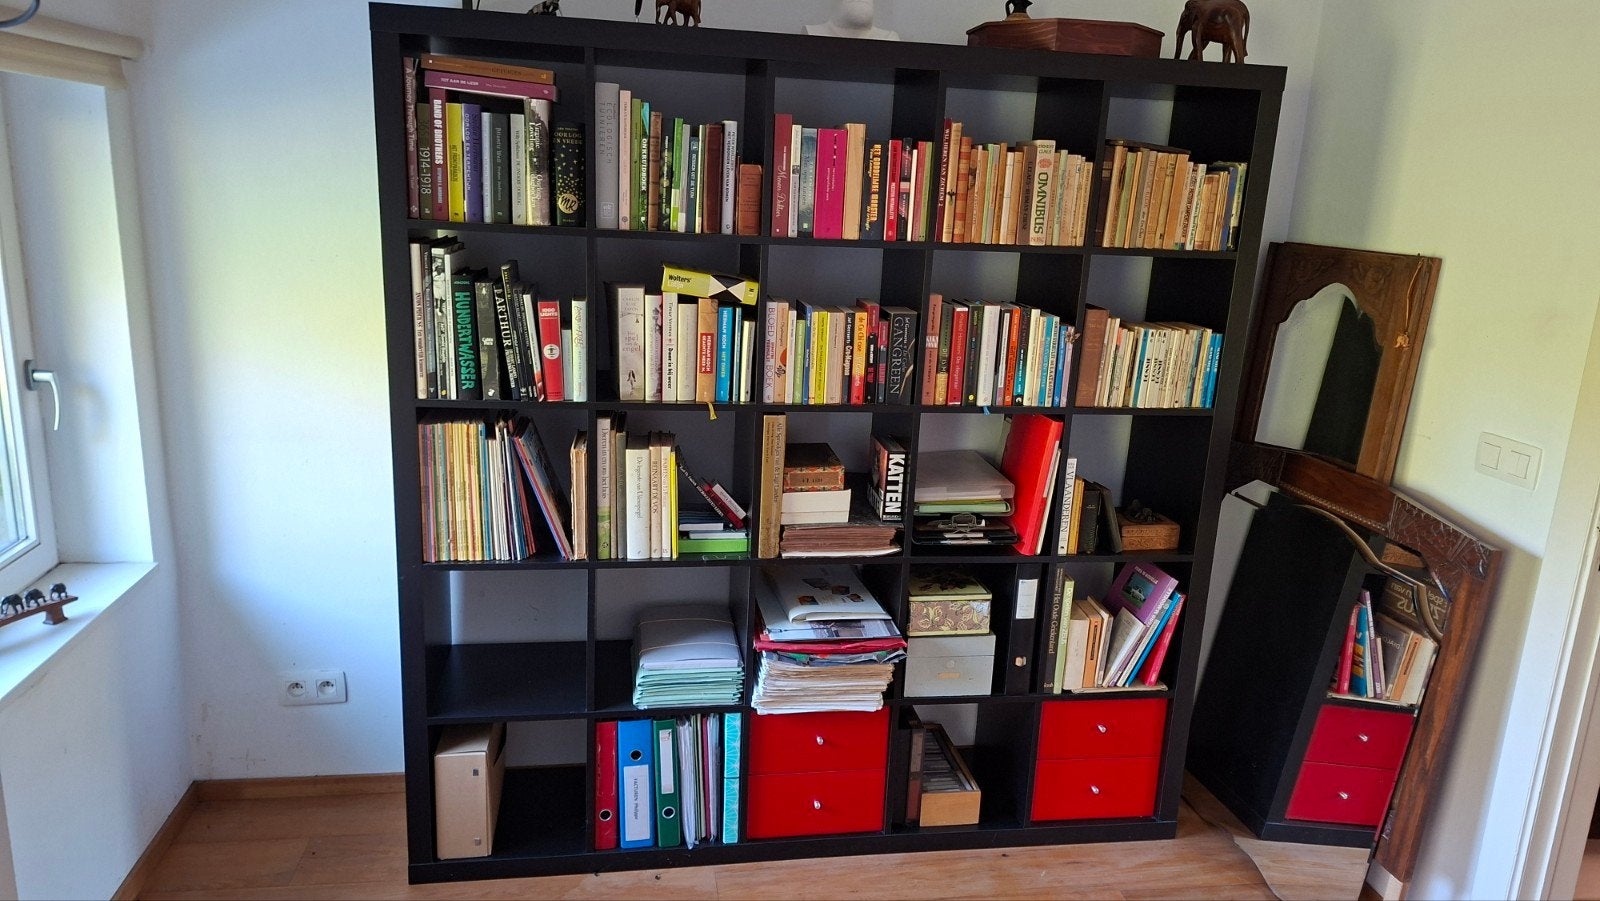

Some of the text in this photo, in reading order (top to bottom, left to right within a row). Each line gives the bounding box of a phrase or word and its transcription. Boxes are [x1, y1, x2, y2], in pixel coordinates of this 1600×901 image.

[407, 104, 415, 133] Through
[433, 99, 443, 164] BAND OF BROTHERS
[534, 122, 542, 149] Virginie
[419, 146, 431, 194] 1914-1918
[870, 144, 882, 222] HET GODDELIJKE MONSTER
[1034, 172, 1049, 235] OMNIBUS
[495, 296, 512, 347] ARTHUR
[454, 291, 476, 390] HUNDERTWASSER
[622, 345, 641, 353] engel
[765, 307, 776, 389] BLOED BOEK
[890, 316, 904, 394] GANGREEN
[843, 345, 853, 376] Cro-Magnon
[955, 356, 961, 364] De
[601, 428, 609, 448] Dieren
[774, 432, 782, 457] Sprookjes
[634, 465, 643, 482] legende
[636, 456, 643, 465] De
[652, 492, 658, 501] DE
[884, 453, 906, 513] KATTEN
[1060, 471, 1075, 533] VLAANDEREN
[1063, 598, 1071, 615] spelen
[1066, 587, 1073, 596] De
[1051, 604, 1060, 620] Oude
[1048, 620, 1058, 654] Griekenland
